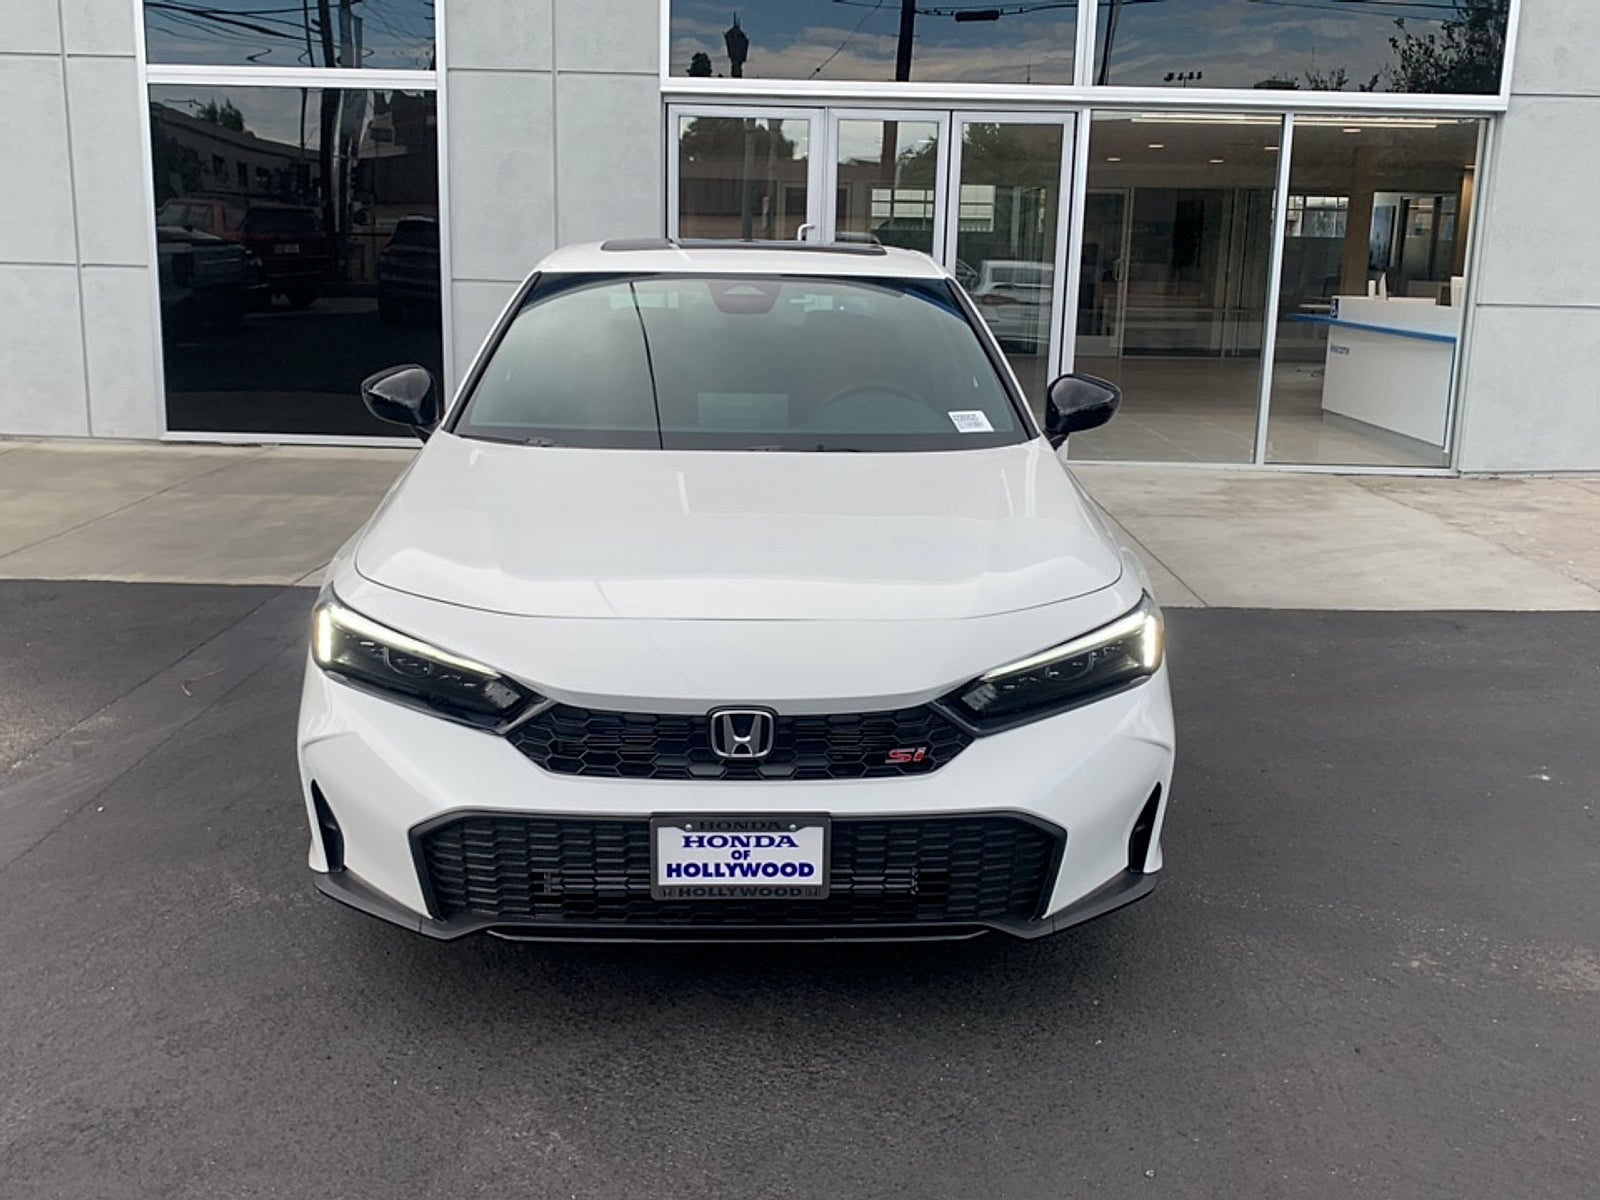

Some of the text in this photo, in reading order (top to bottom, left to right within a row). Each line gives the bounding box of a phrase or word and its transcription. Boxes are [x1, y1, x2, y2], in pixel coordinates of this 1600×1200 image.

[700, 821, 782, 831] HONDA
[682, 835, 799, 848] HONDA
[731, 850, 751, 861] OF
[666, 862, 815, 878] HOLLYWOOD
[678, 886, 801, 897] HOLLYWOOD
